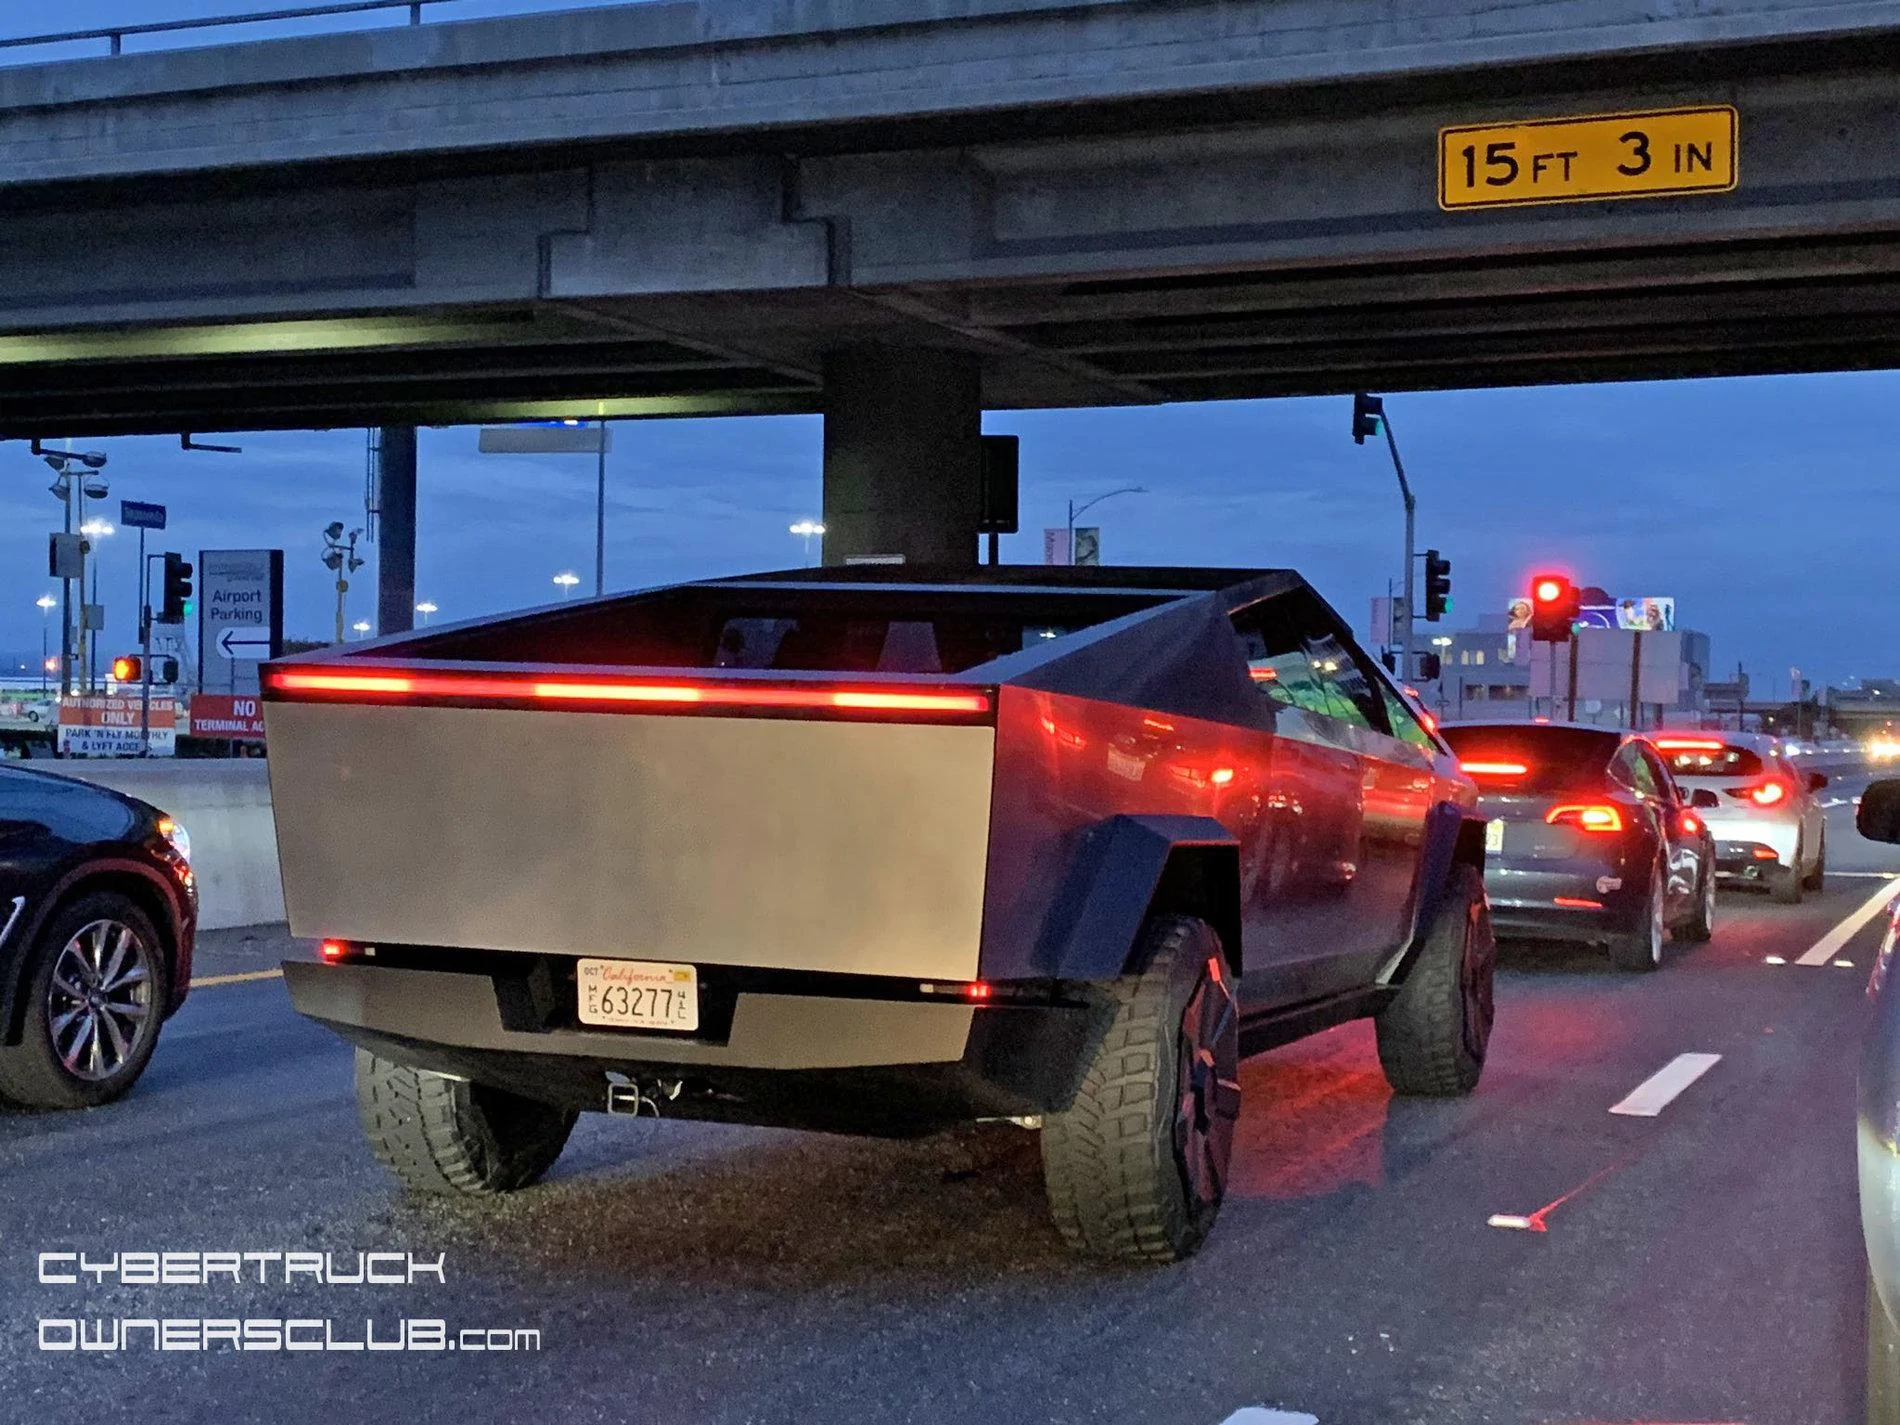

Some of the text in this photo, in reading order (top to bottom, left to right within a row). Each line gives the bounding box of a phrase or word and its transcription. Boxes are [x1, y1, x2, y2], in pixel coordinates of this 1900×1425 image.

[1462, 131, 1713, 188] 15 FT 3 IN
[212, 589, 262, 605] Airport
[210, 607, 263, 624] Parking
[233, 700, 257, 717] NO
[101, 710, 136, 725] ONLY
[195, 719, 249, 732] TERMINAL
[65, 728, 91, 738] PARK
[584, 966, 667, 985] OCT California
[601, 986, 672, 1018] 63277
